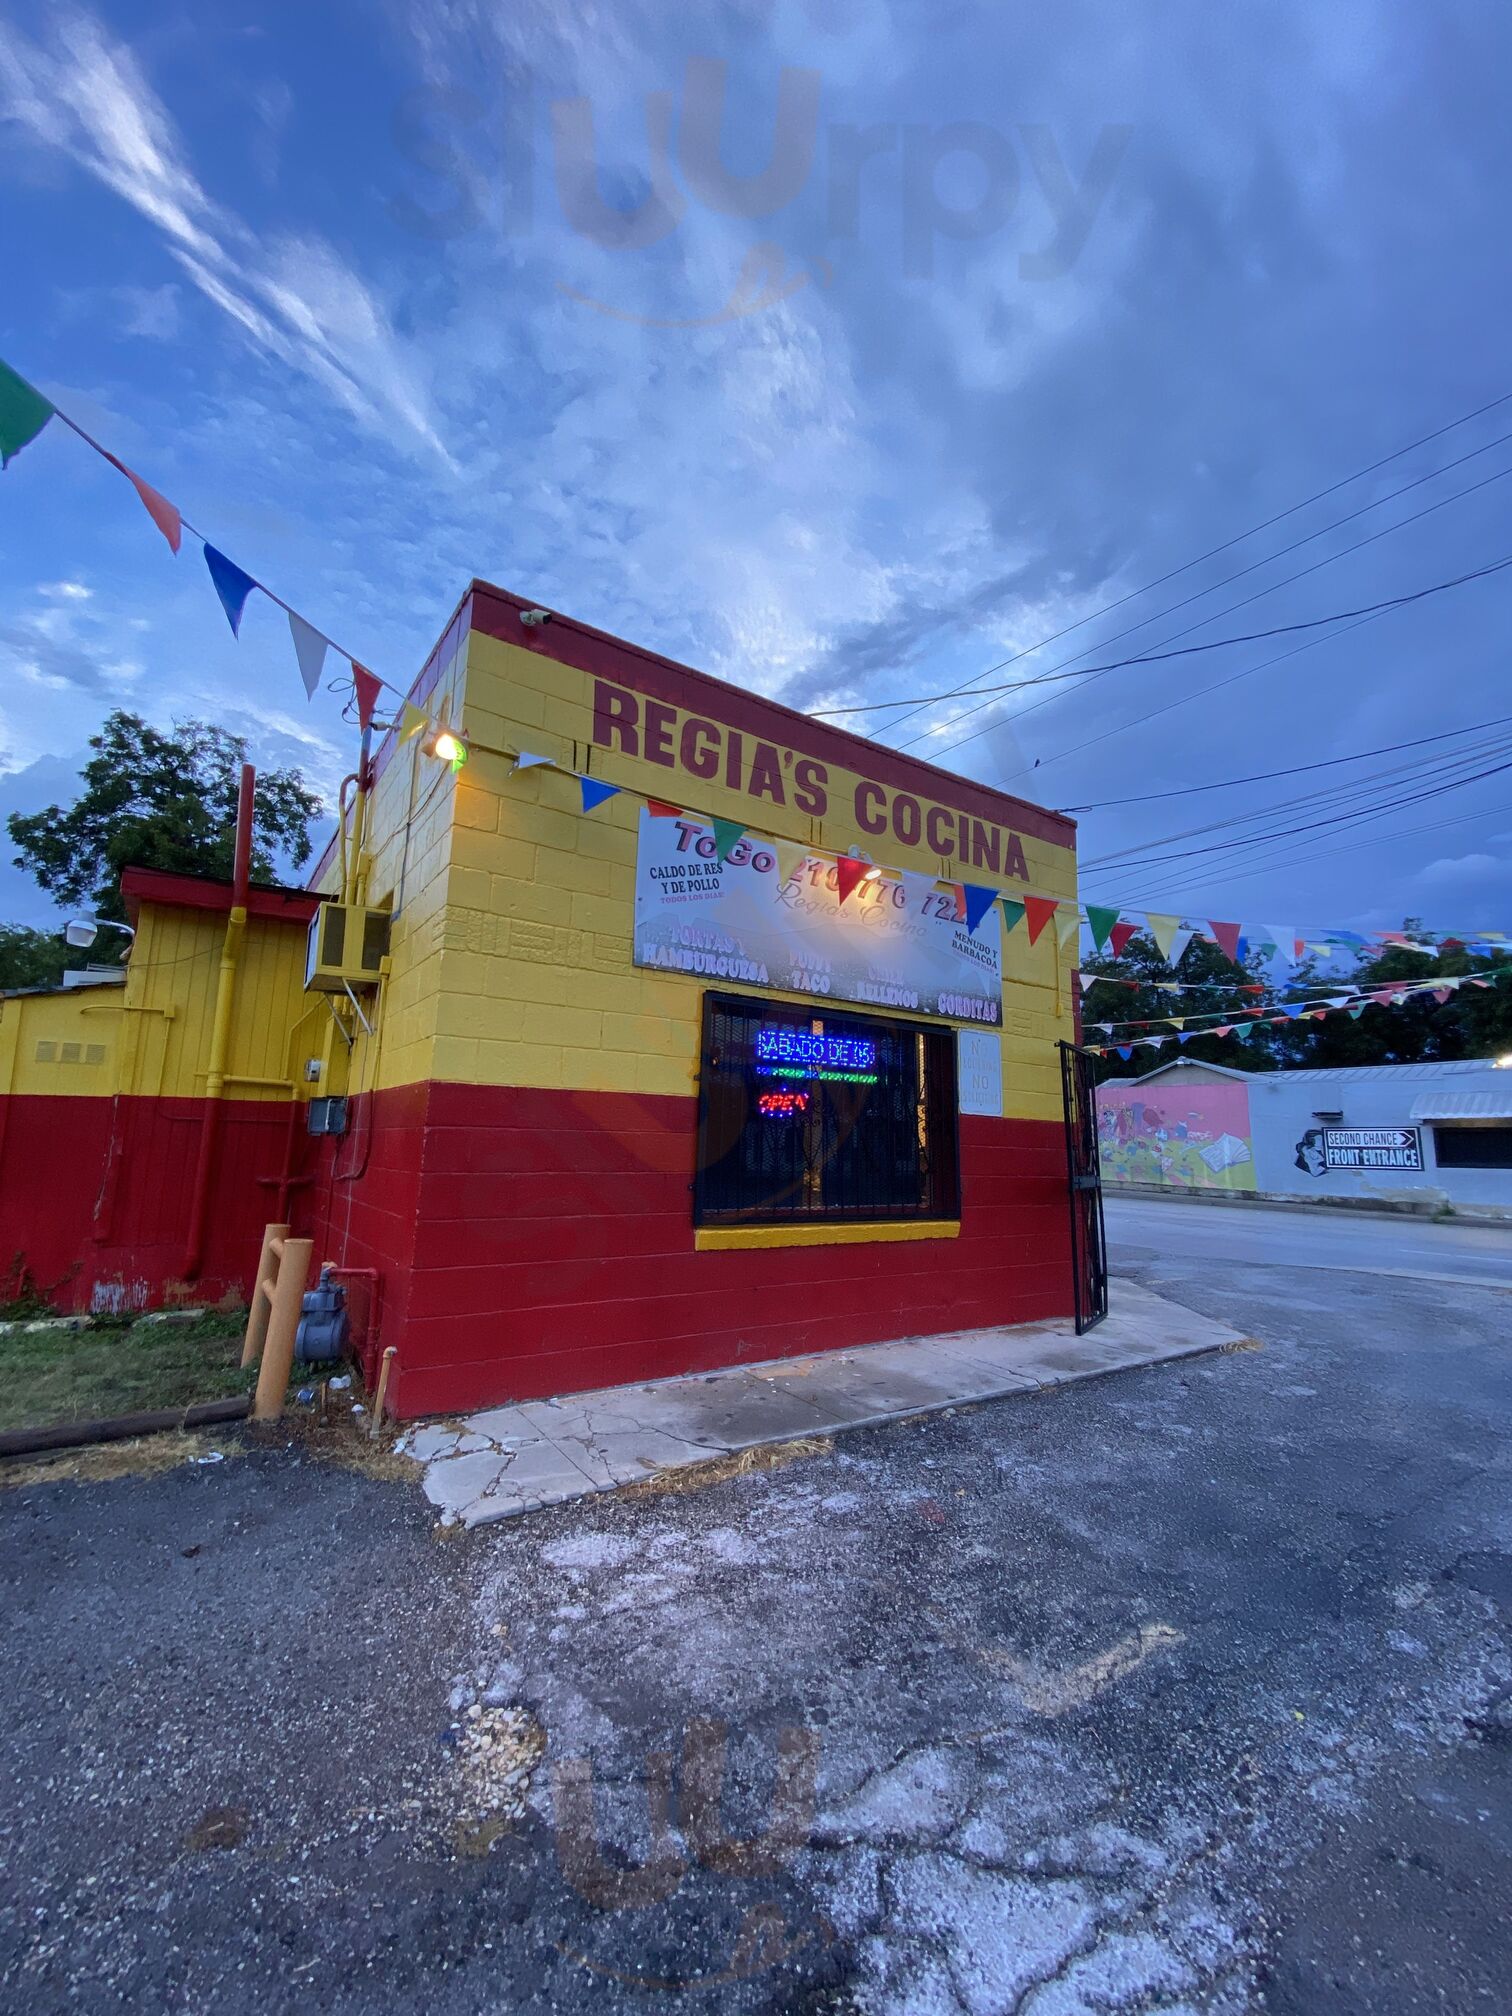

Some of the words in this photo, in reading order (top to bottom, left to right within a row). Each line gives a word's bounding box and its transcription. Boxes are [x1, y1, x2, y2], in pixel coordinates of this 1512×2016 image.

[592, 679, 829, 817] REGIA'S
[854, 781, 1031, 883] COCINA
[650, 864, 687, 879] CALDO
[689, 863, 703, 876] DE
[705, 862, 723, 875] RES
[661, 882, 669, 894] Y
[672, 880, 686, 893] DE
[688, 877, 720, 891] POLLO
[955, 930, 991, 955] MENUDO
[992, 949, 998, 958] Y
[952, 940, 998, 969] BARBACOA
[791, 970, 831, 994] TACO
[829, 1043, 849, 1062] DE
[972, 1074, 989, 1090] NO
[759, 1093, 808, 1112] OPEN
[1329, 1132, 1361, 1146] SECOND
[1363, 1132, 1398, 1146] CHANCE
[1329, 1148, 1360, 1165] FRONT
[1362, 1149, 1418, 1167] ENTRANCE
